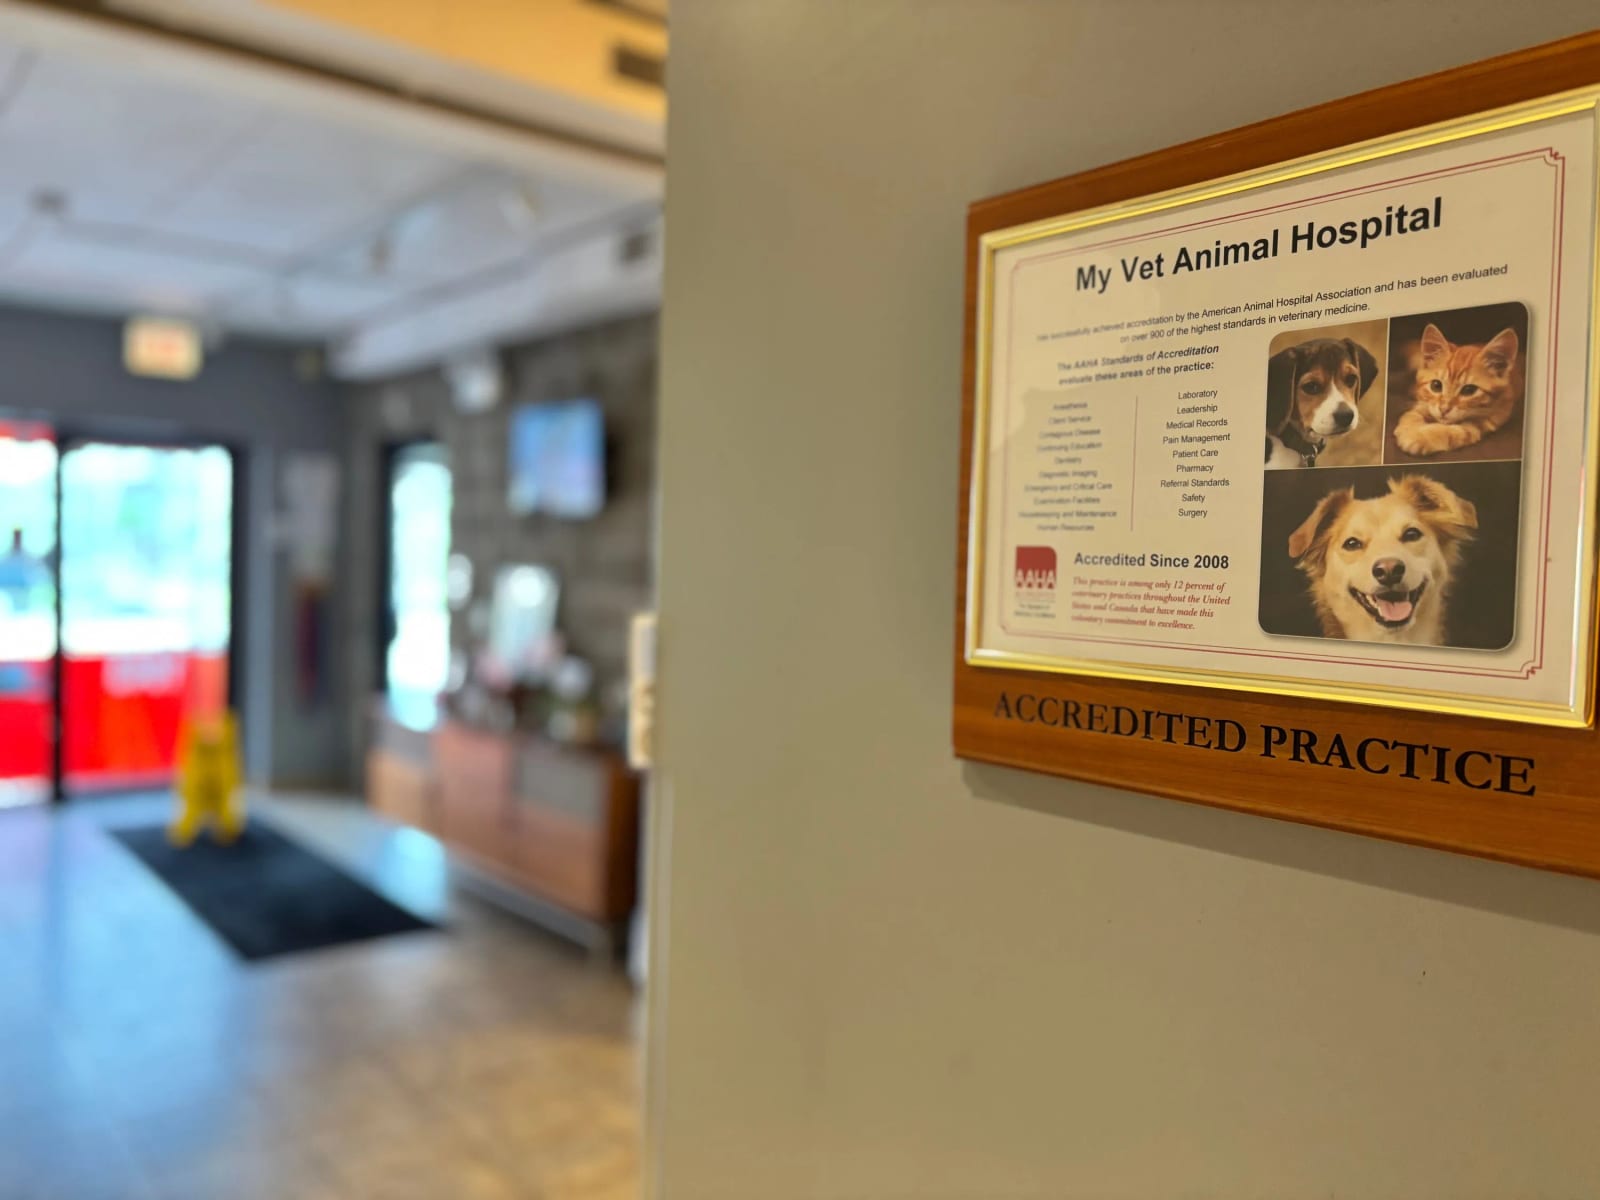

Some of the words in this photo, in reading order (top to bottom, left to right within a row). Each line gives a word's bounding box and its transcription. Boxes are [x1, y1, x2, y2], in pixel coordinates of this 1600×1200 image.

[1077, 264, 1111, 294] My
[1121, 253, 1164, 283] Vet
[1173, 228, 1279, 275] Animal
[1291, 197, 1442, 253] Hospital
[1126, 315, 1173, 328] accreditation
[1176, 312, 1185, 323] by
[1187, 311, 1199, 320] the
[1202, 305, 1241, 317] American
[1243, 299, 1274, 312] Animal
[1276, 293, 1313, 309] Hospital
[1315, 285, 1371, 301] Association
[1374, 281, 1394, 293] and
[1397, 278, 1417, 290] has
[1420, 274, 1448, 287] been
[1452, 264, 1508, 282] evaluated
[1131, 334, 1148, 342] over
[1150, 329, 1164, 339] 900
[1166, 328, 1175, 337] of
[1177, 326, 1188, 336] the
[1191, 322, 1221, 335] highest
[1223, 316, 1266, 330] standards
[1269, 314, 1276, 324] in
[1278, 308, 1322, 323] veterinary
[1325, 303, 1370, 316] medicine.
[1101, 352, 1143, 366] Standards
[1146, 351, 1156, 361] of
[1157, 345, 1219, 360] Accreditation
[1095, 372, 1117, 382] these
[1120, 369, 1143, 379] areas
[1146, 366, 1155, 376] of
[1157, 364, 1171, 375] the
[1174, 361, 1214, 375] practice:
[1178, 389, 1218, 400] Laboratory
[1176, 403, 1218, 414] Leadership
[1166, 420, 1194, 429] Medical
[1196, 417, 1228, 428] Records
[1163, 435, 1179, 444] Pain
[1180, 433, 1231, 444] Management
[1172, 449, 1198, 459] Patient
[1200, 448, 1218, 457] Care
[1176, 464, 1214, 473] Pharmacy
[1160, 479, 1189, 488] Referral
[1191, 477, 1230, 487] Standards
[1182, 493, 1205, 503] Safety
[1178, 507, 1208, 519] Surgery
[1074, 552, 1145, 566] Accredited
[1150, 553, 1189, 568] Since
[1193, 554, 1229, 569] 2008
[1015, 567, 1057, 590] AAHA
[1127, 580, 1153, 590] among
[1155, 580, 1170, 591] only
[1174, 580, 1184, 589] 12
[1185, 581, 1214, 592] percent
[1217, 582, 1227, 593] of
[1108, 592, 1141, 602] practices
[1143, 592, 1186, 604] throughout
[1188, 594, 1200, 603] the
[1203, 595, 1231, 605] United
[1109, 603, 1138, 612] Canada
[1140, 604, 1155, 613] that
[1157, 606, 1175, 615] have
[1176, 608, 1197, 616] made
[1200, 608, 1214, 618] this
[1158, 620, 1195, 630] excellence.
[994, 691, 1247, 754] ACCREDITED
[1261, 722, 1536, 797] PRACTICE
